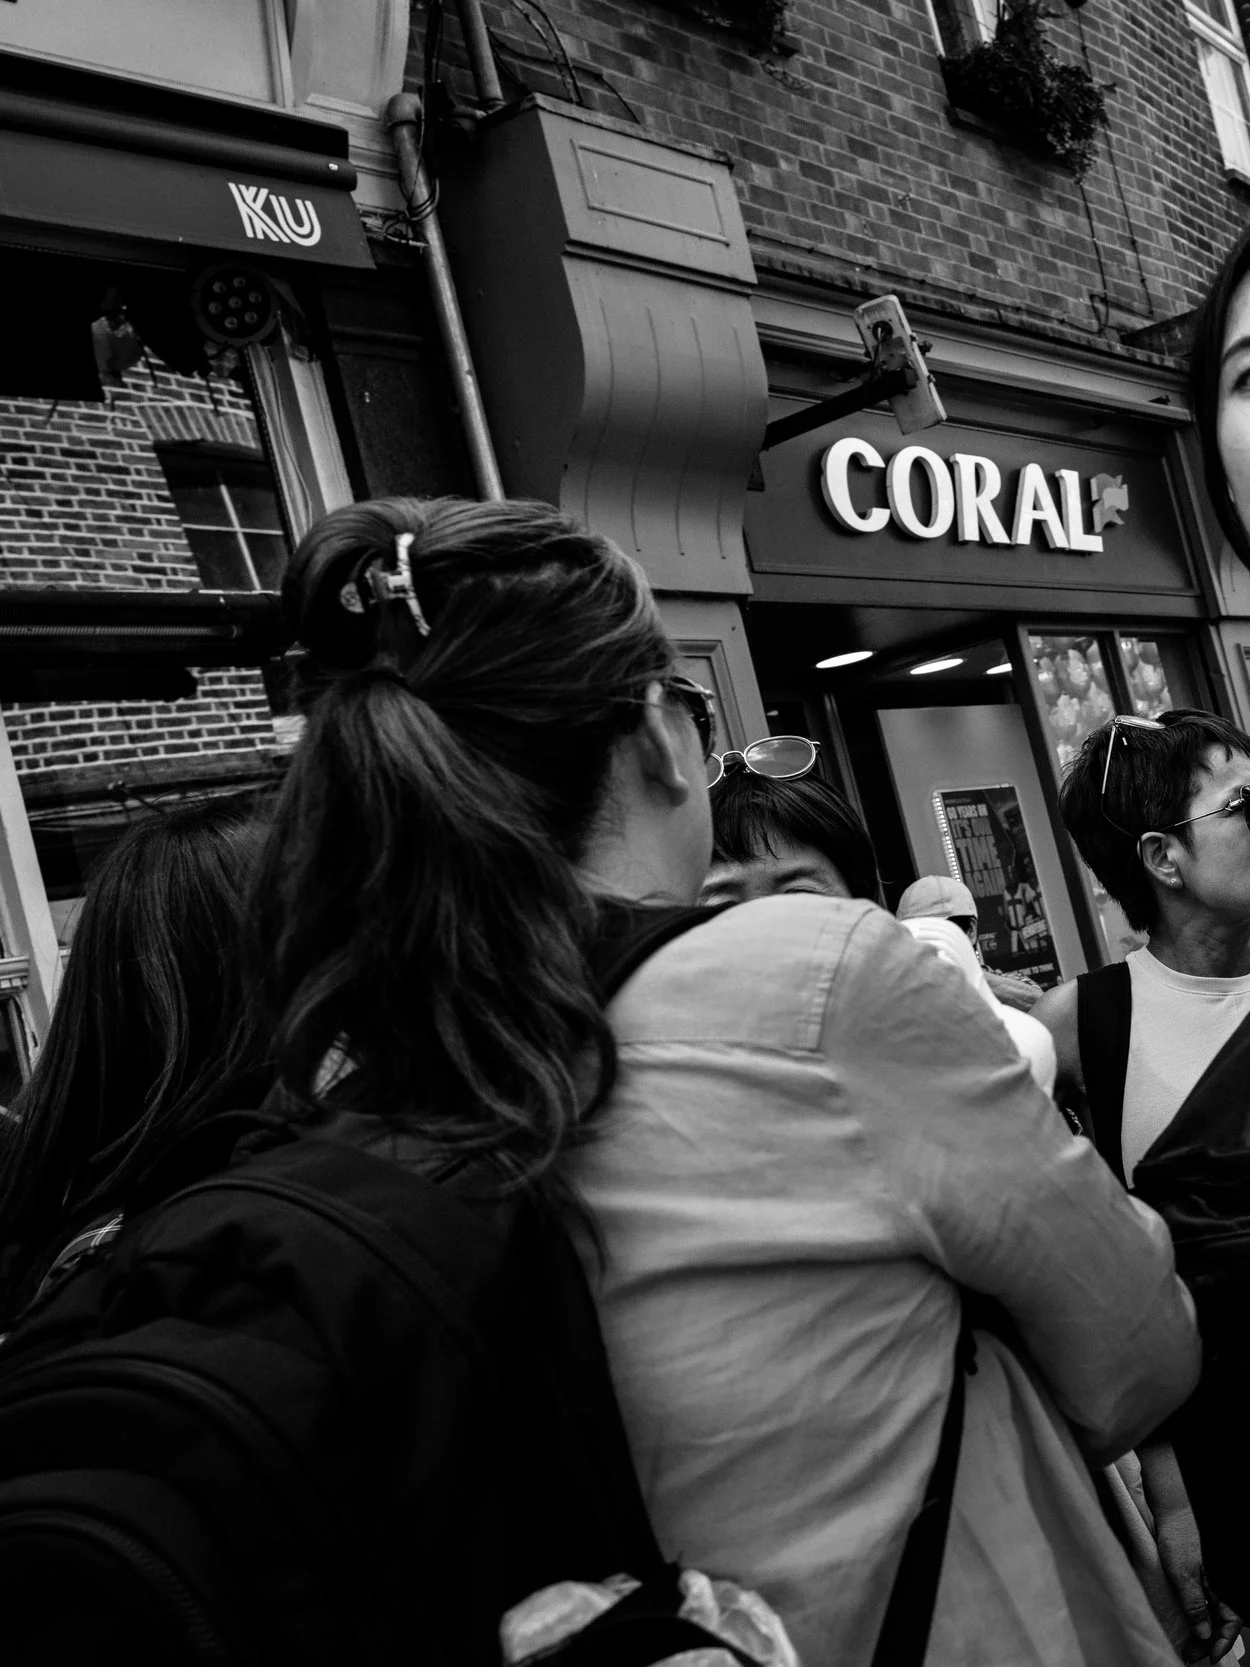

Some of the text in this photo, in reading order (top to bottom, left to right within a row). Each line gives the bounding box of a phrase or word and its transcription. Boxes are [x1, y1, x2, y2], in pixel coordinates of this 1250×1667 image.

[228, 182, 321, 246] KU
[820, 437, 1104, 553] CORAL
[954, 835, 1001, 873] TIME
